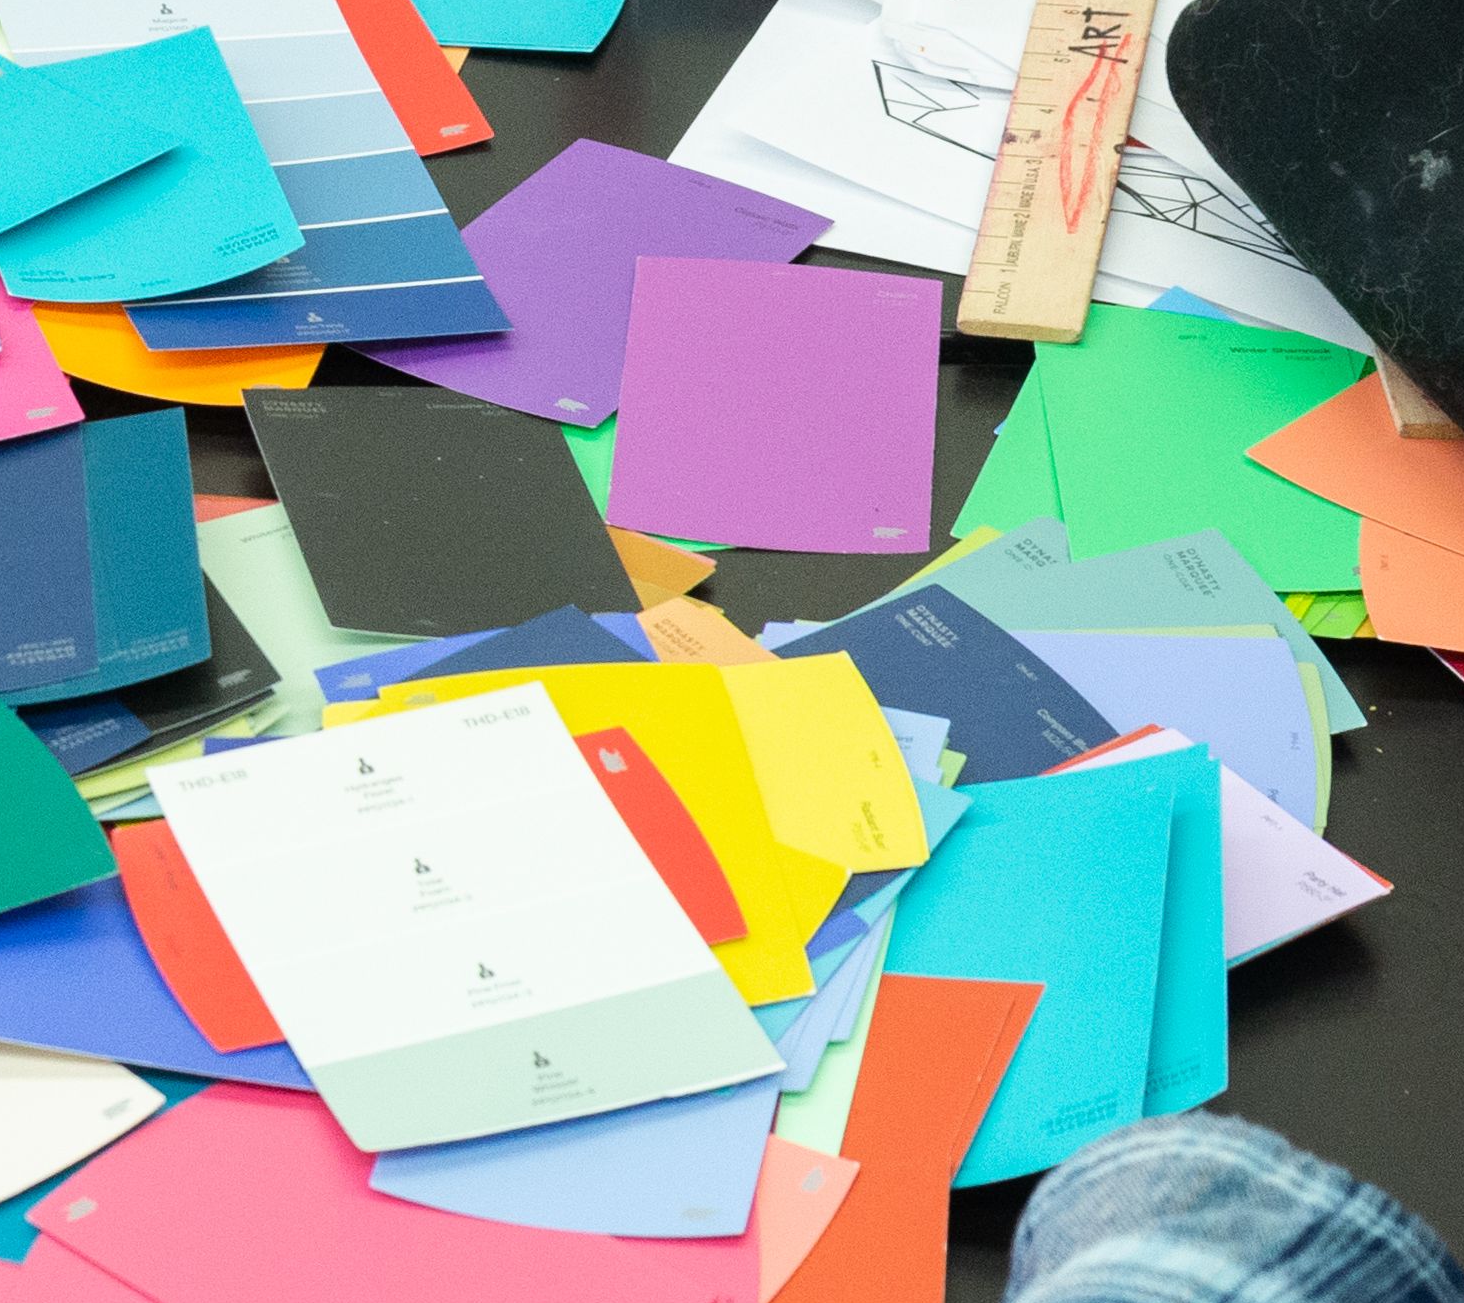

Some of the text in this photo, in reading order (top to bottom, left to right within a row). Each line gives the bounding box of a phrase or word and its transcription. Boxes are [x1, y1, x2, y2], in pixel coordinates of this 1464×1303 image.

[1068, 7, 1130, 64] ART
[1229, 346, 1332, 354] Winter Shamrock
[1185, 548, 1221, 591] DYNASTY
[916, 604, 961, 641] DYNASTY
